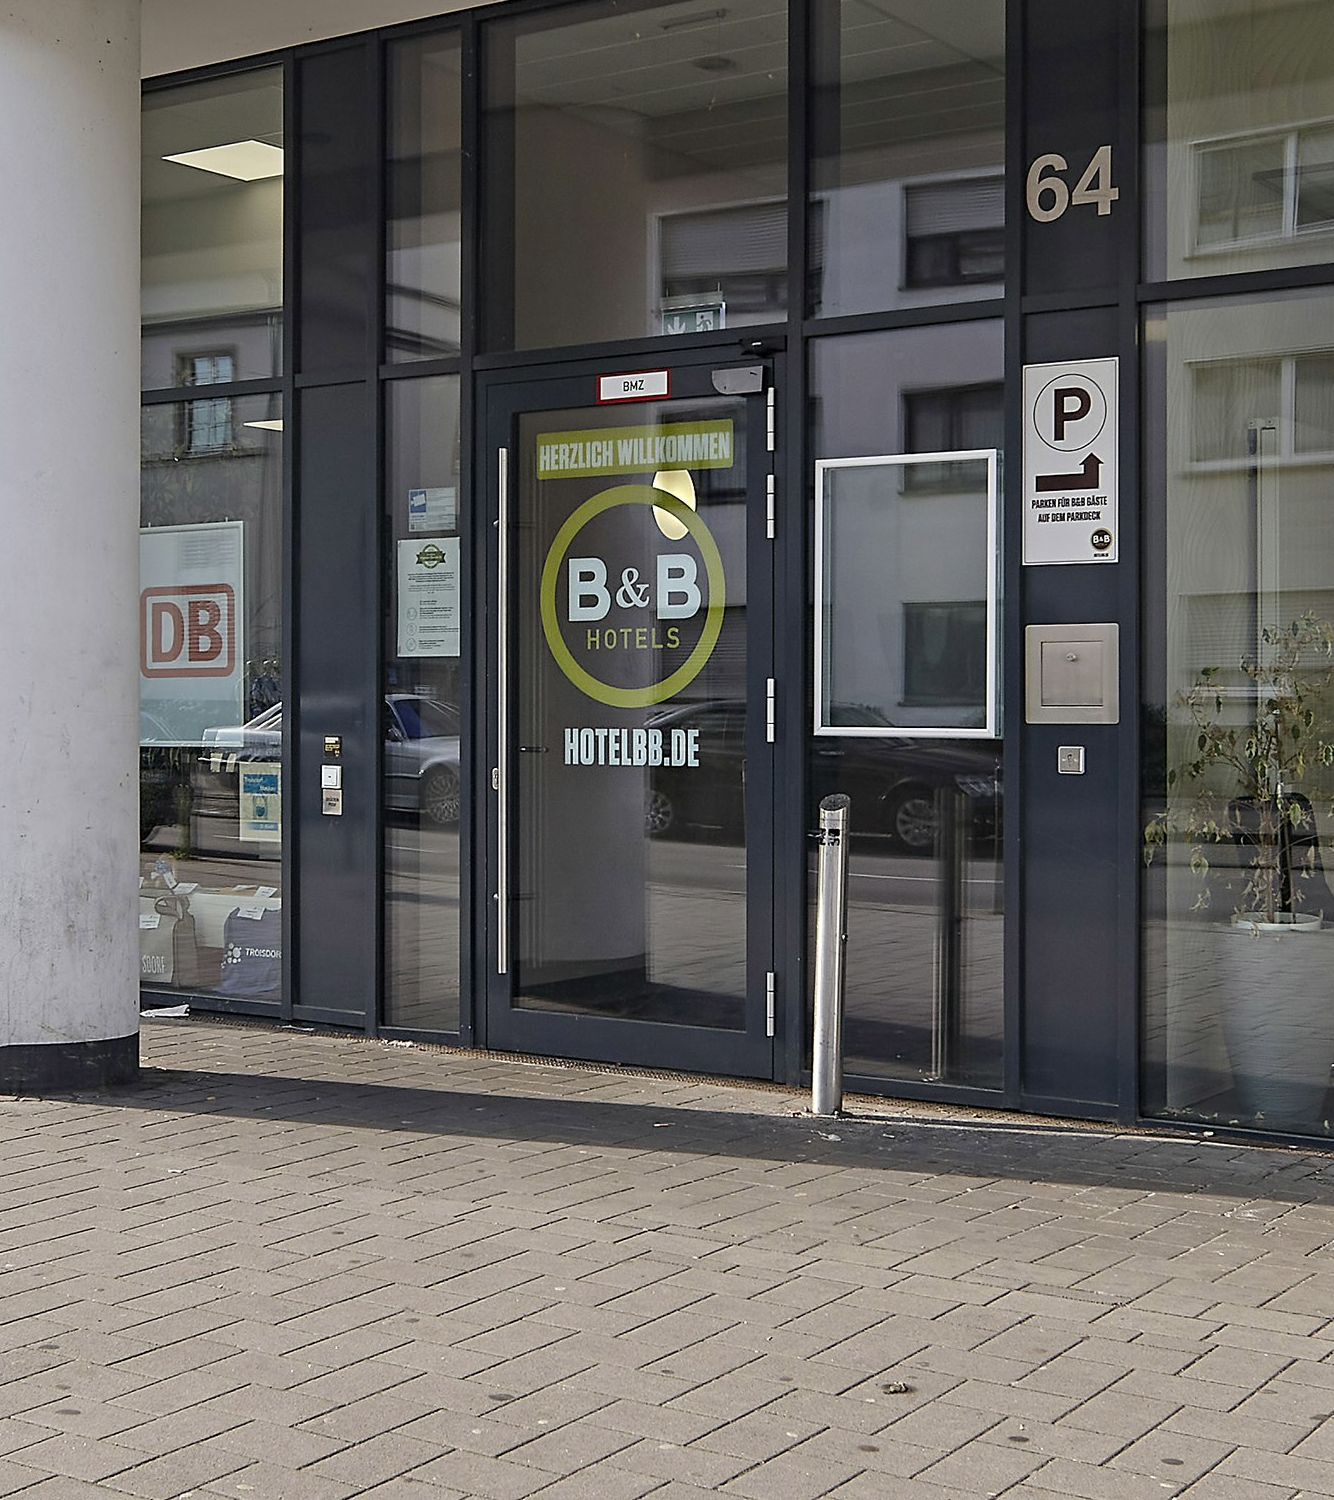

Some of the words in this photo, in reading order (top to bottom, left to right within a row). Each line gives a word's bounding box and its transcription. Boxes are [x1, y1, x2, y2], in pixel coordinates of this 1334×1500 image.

[1026, 145, 1119, 223] 64
[622, 380, 645, 392] BMZ
[1053, 387, 1092, 442] P
[539, 440, 614, 472] HERZLICH
[617, 431, 731, 467] WILLKOMMEN
[1031, 499, 1057, 509] PARKEN
[1058, 496, 1070, 508] FÜR
[1086, 495, 1108, 506] GÄSTE
[1038, 513, 1051, 522] AUF
[1051, 512, 1066, 522] DEM
[1066, 510, 1101, 522] PARKDECK
[568, 553, 702, 622] B&B
[150, 599, 224, 664] DB
[586, 627, 681, 650] HOTELS
[564, 727, 700, 767] HOTELBB.DE
